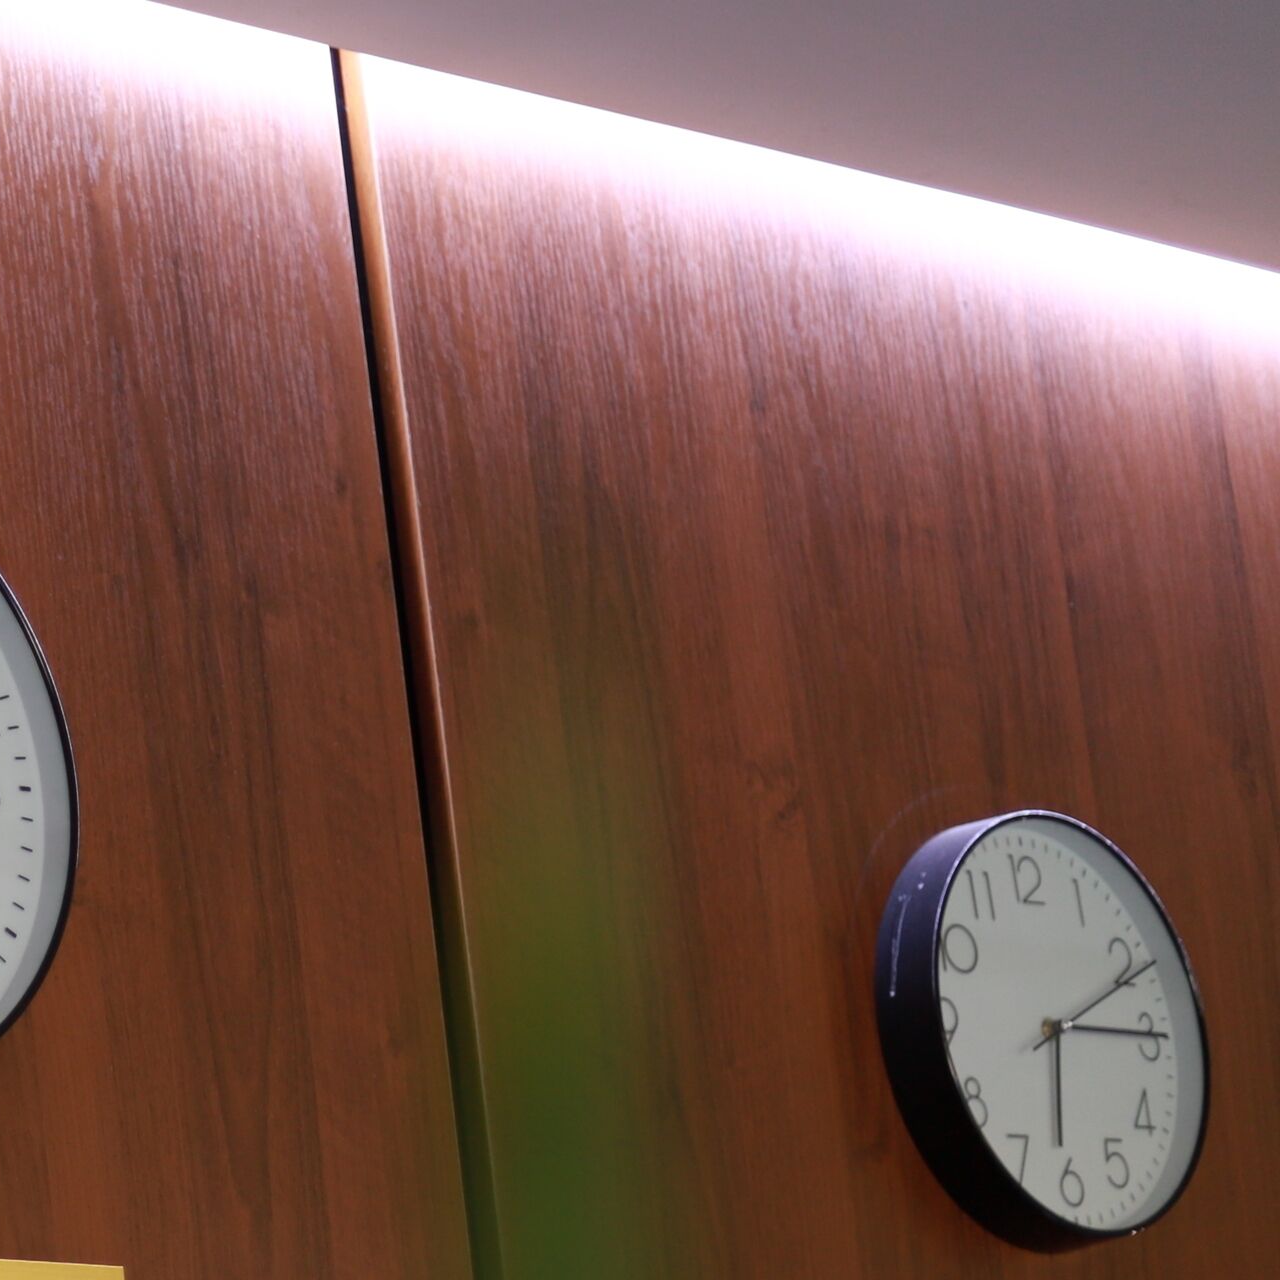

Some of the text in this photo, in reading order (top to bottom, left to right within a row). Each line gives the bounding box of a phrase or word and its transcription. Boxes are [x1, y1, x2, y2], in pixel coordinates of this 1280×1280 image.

[966, 868, 996, 922] 11
[1007, 853, 1046, 906] 12
[1073, 877, 1085, 928] 1
[1108, 937, 1135, 988] 2
[1138, 1012, 1160, 1062] 3
[964, 1076, 988, 1129] 8
[1134, 1087, 1156, 1137] 4
[1006, 1134, 1029, 1189] 7
[1059, 1156, 1085, 1208] 6
[1104, 1137, 1130, 1189] 5
